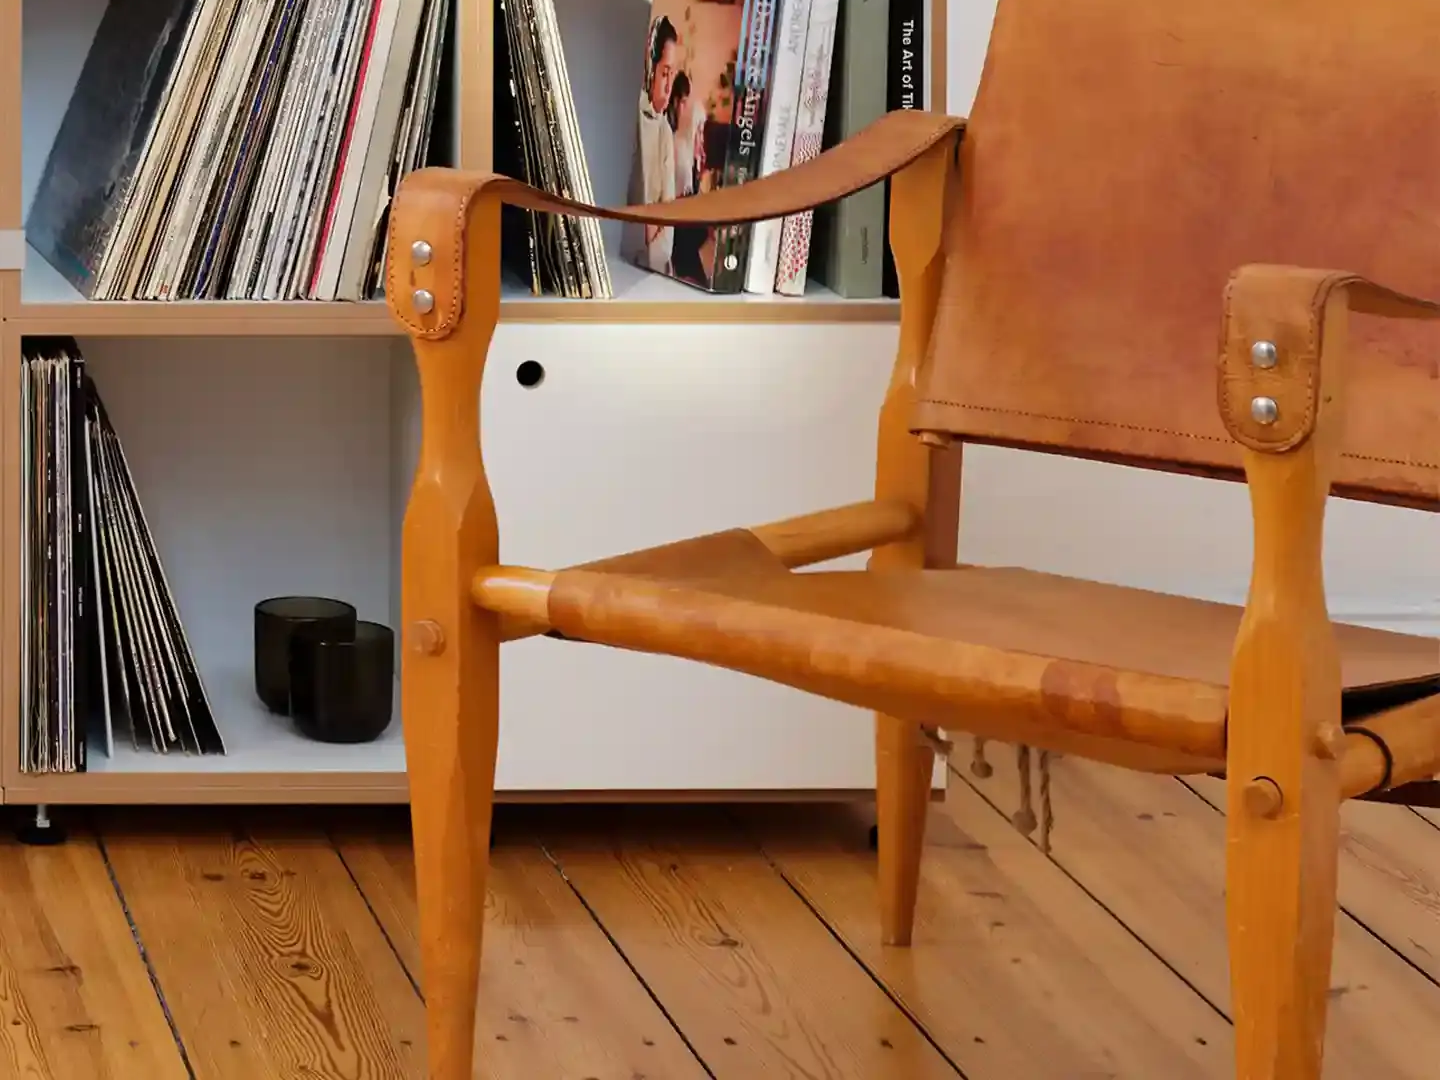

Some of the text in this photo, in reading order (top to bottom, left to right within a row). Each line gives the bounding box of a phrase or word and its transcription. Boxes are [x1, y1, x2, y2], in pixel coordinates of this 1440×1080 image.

[902, 20, 914, 45] The
[902, 49, 914, 72] Art
[902, 74, 914, 90] of
[736, 86, 762, 156] Angels
